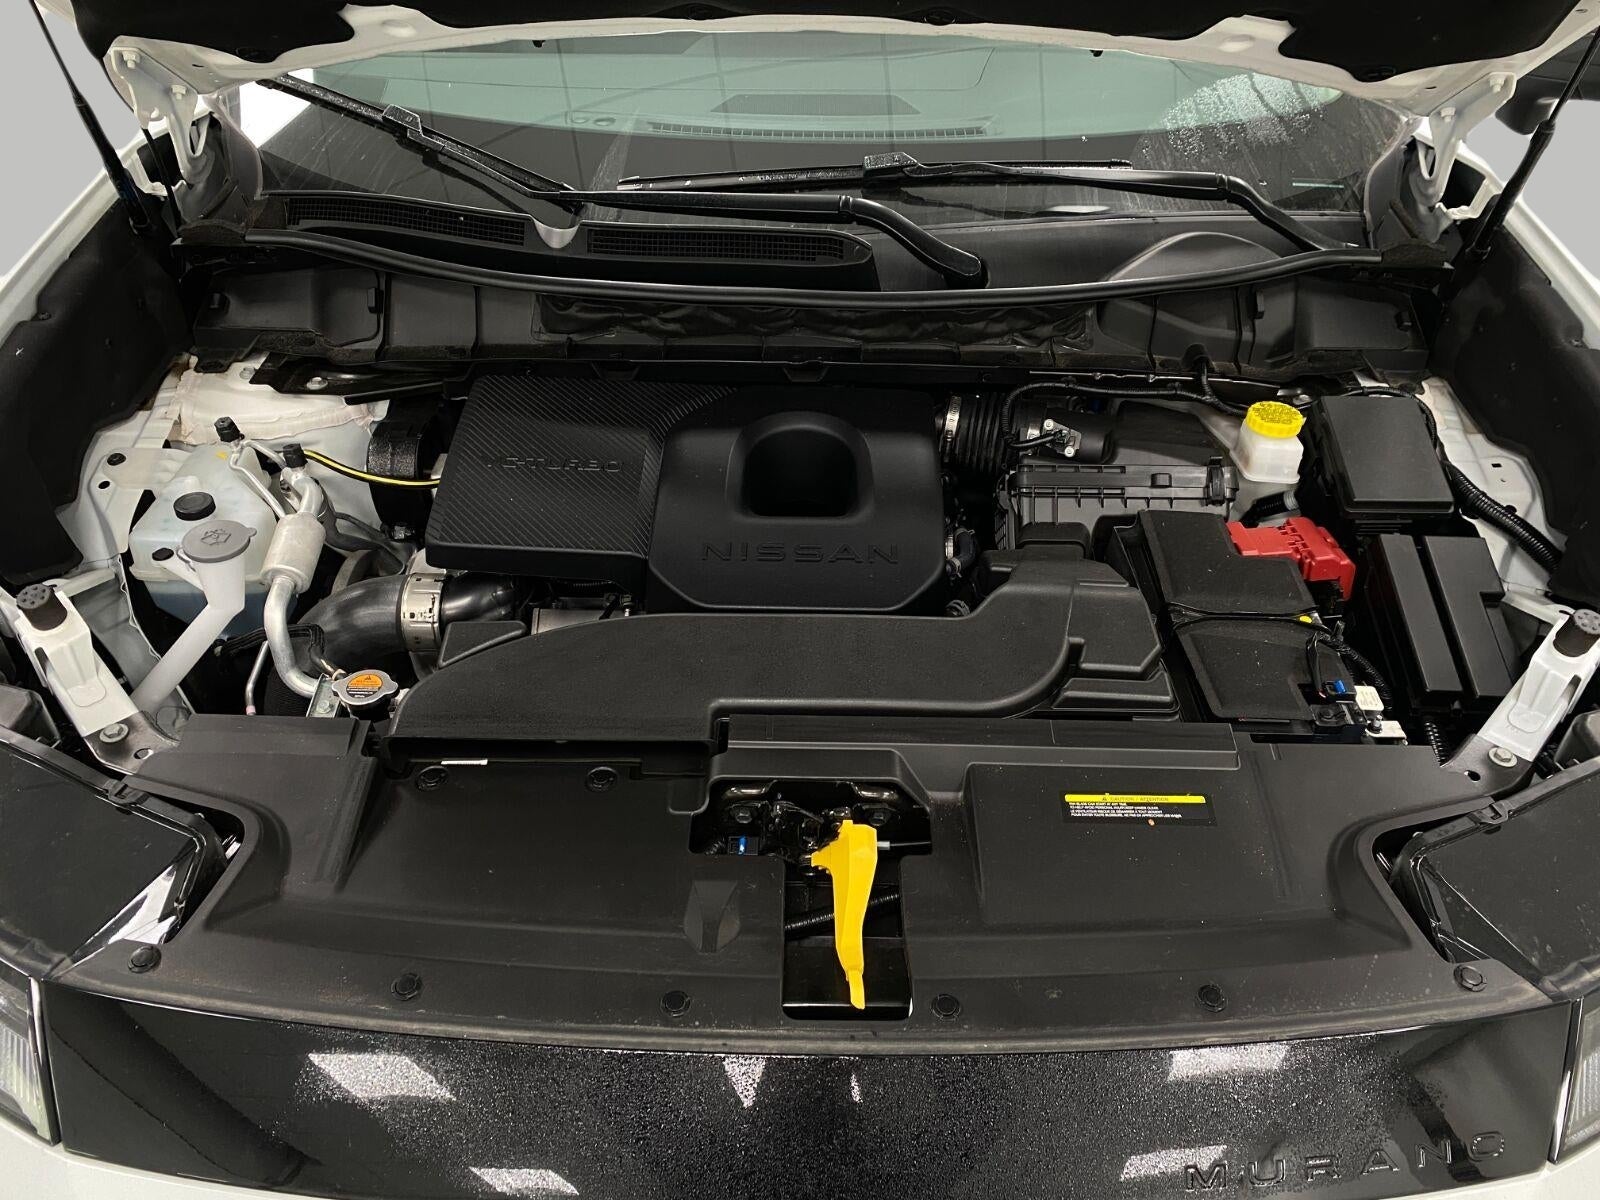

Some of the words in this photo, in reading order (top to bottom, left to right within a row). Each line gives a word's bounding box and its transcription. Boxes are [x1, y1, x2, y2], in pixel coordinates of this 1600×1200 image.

[483, 457, 622, 473] C-TURBO
[701, 542, 899, 564] NISSAN
[1185, 1132, 1505, 1192] MURANO
